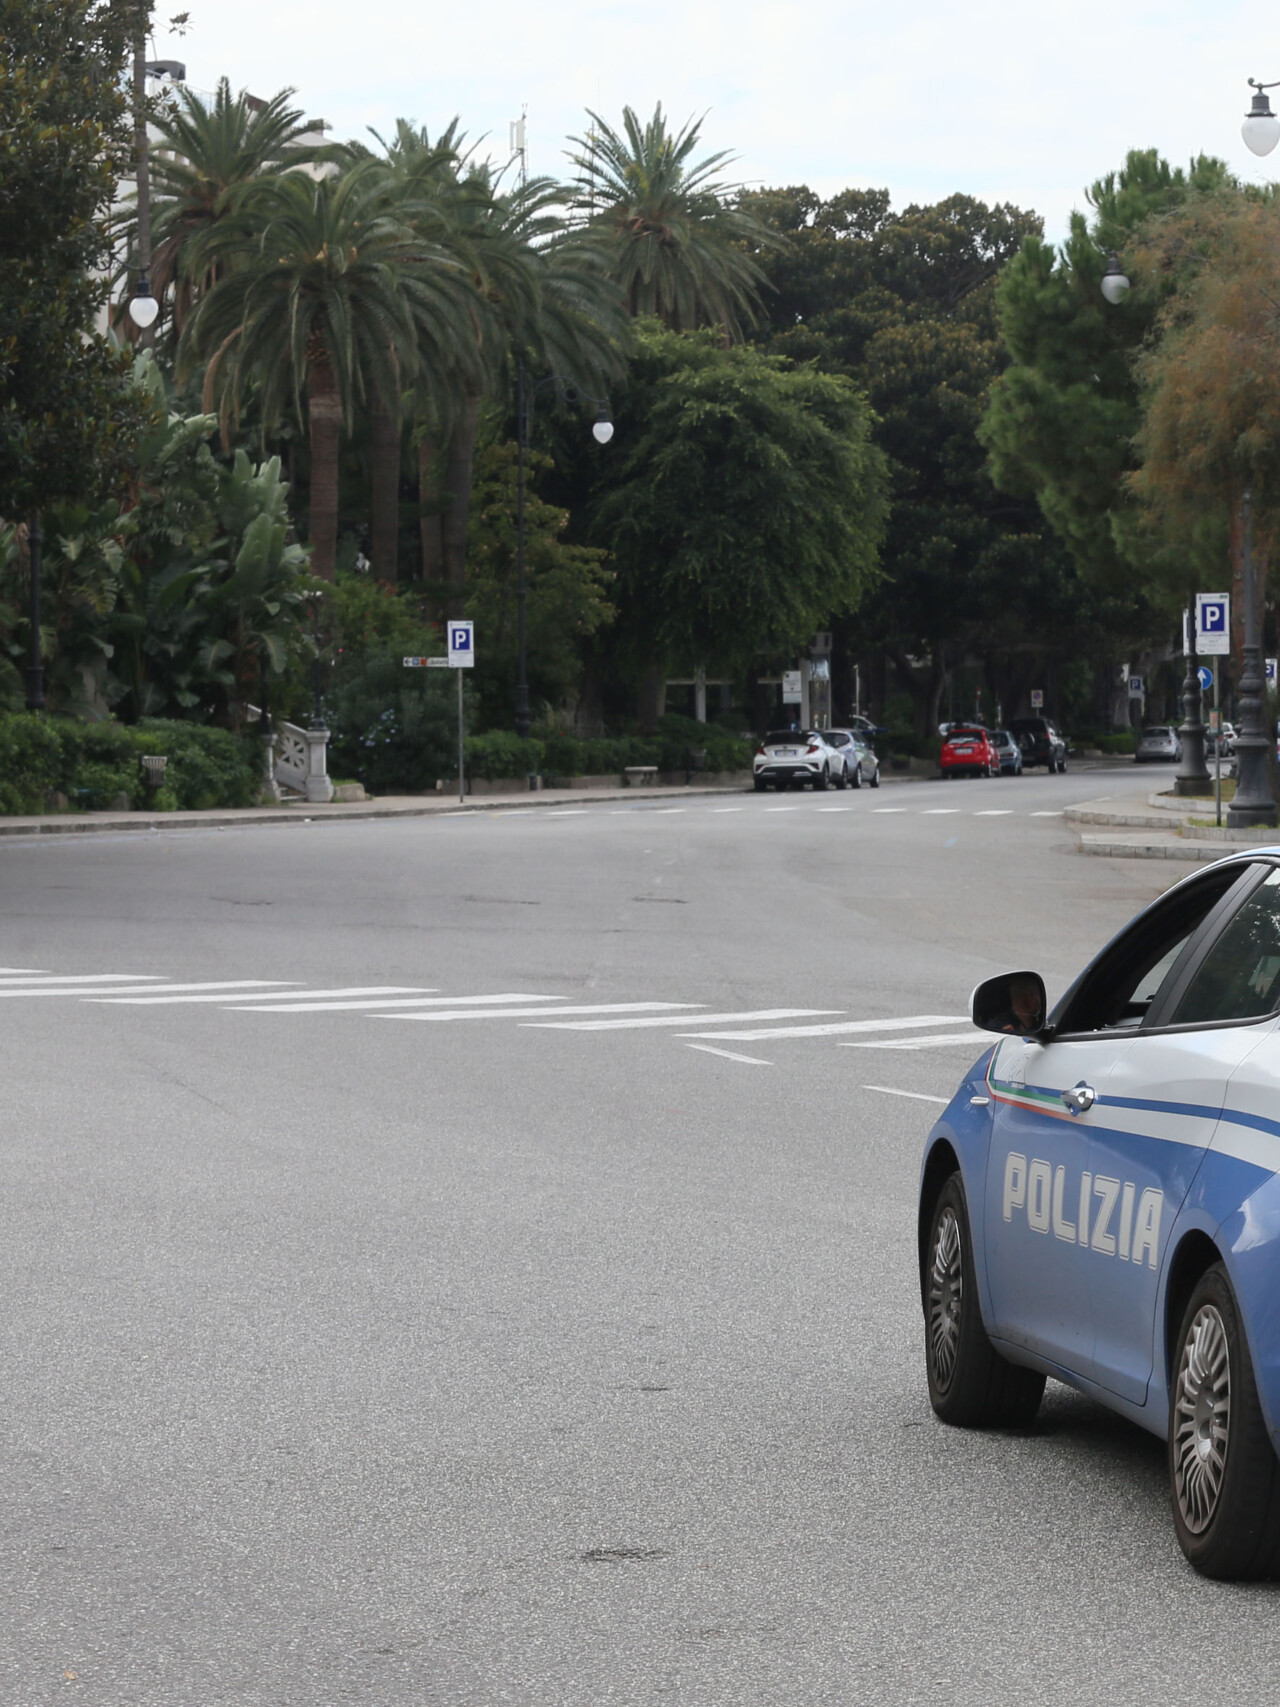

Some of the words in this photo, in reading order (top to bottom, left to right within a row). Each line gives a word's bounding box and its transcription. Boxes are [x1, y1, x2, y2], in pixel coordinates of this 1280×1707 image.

[1206, 606, 1220, 629] P
[455, 630, 467, 649] P
[1131, 680, 1139, 690] P
[1002, 1151, 1165, 1271] POLIZIA
